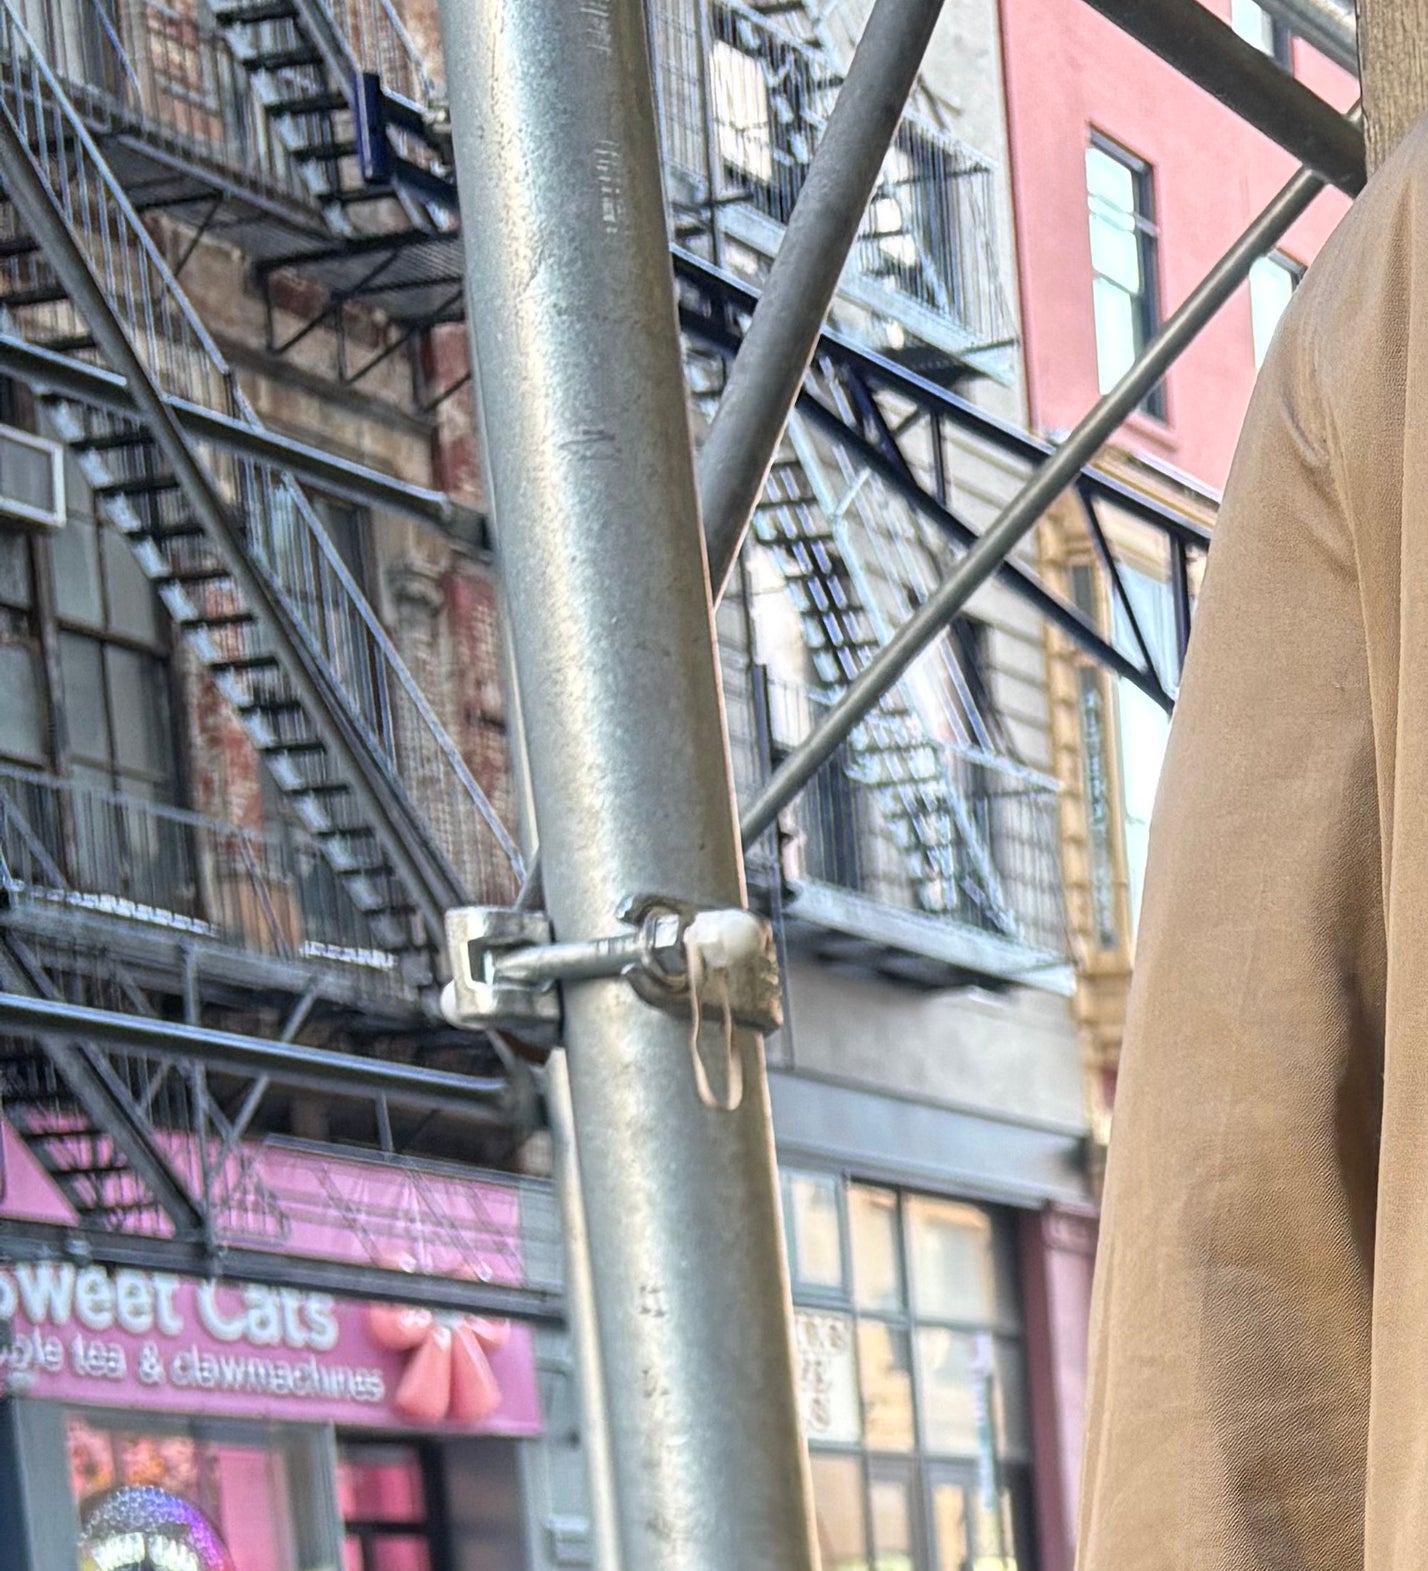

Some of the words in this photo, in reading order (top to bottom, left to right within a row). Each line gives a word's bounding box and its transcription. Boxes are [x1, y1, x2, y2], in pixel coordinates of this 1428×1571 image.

[196, 1278, 340, 1351] Cats
[72, 1331, 127, 1378] tea
[137, 1340, 165, 1386] &
